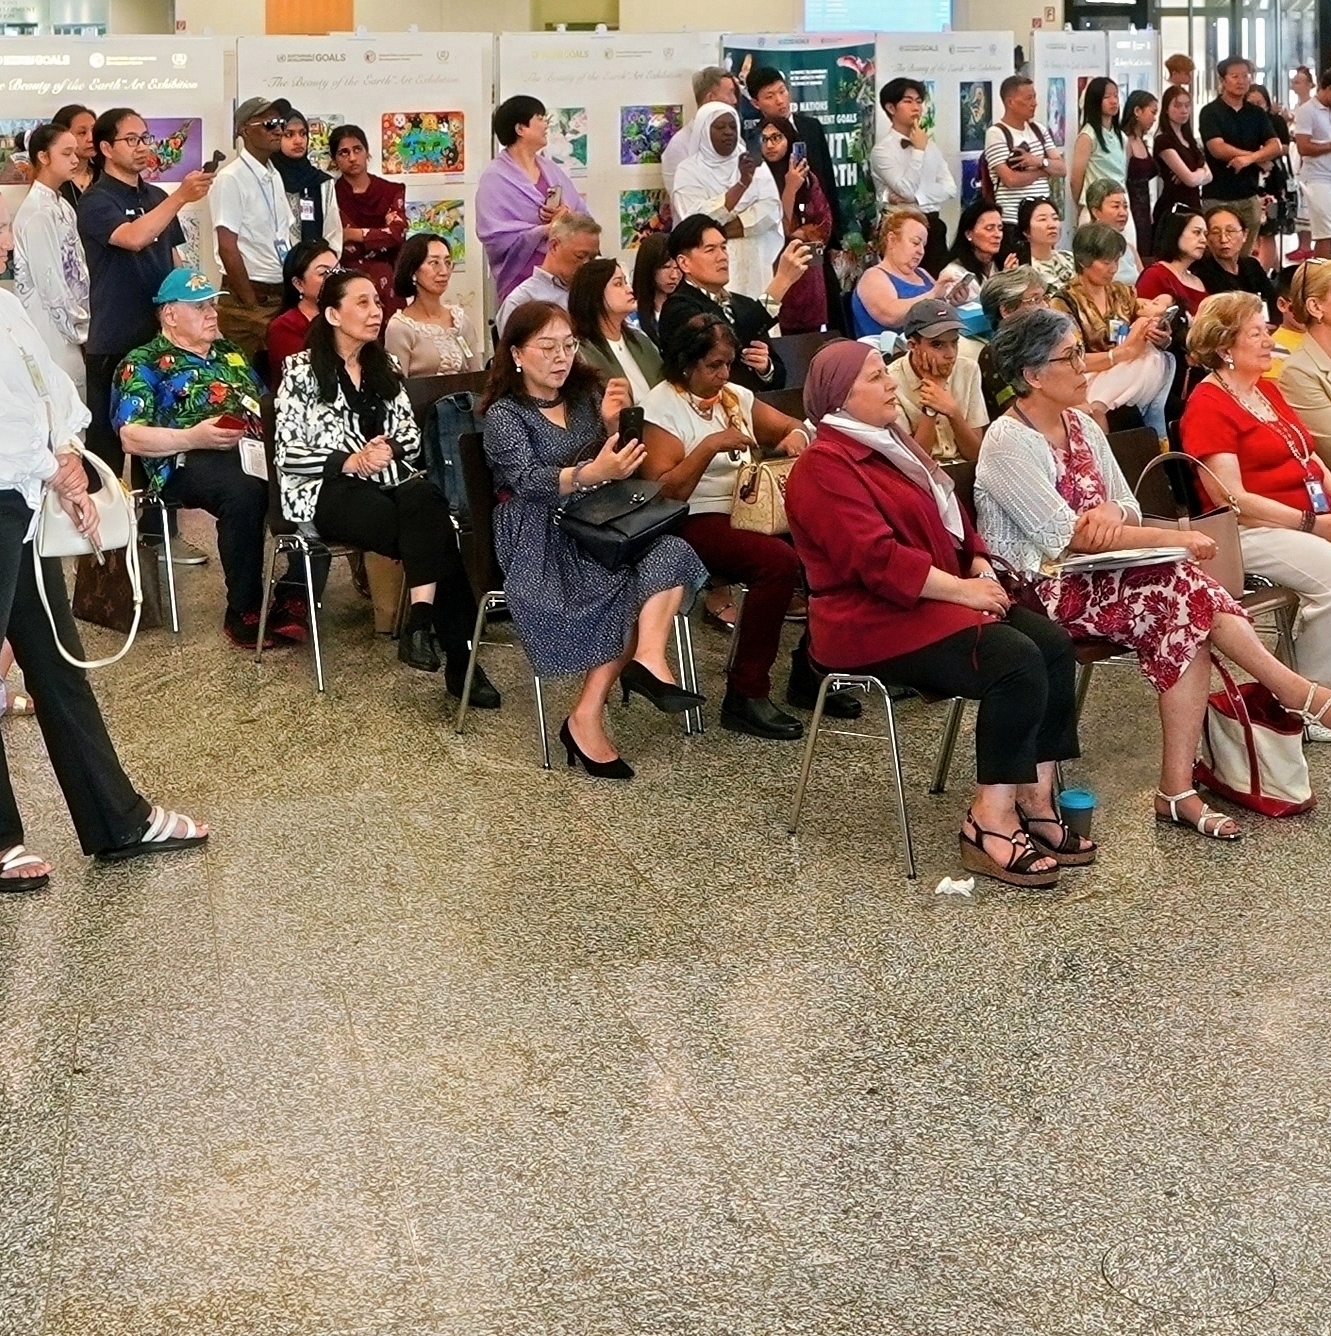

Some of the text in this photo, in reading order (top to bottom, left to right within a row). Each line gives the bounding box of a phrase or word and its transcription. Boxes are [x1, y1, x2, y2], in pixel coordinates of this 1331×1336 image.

[36, 54, 70, 66] GOALS
[315, 53, 346, 62] GOALS
[8, 78, 51, 95] Beauty
[51, 77, 68, 95] of
[67, 78, 85, 91] the
[125, 78, 145, 90] Art
[147, 77, 198, 90] Exhibition
[292, 76, 328, 91] Beauty
[331, 75, 344, 90] of
[344, 76, 360, 87] the
[800, 101, 828, 112] NATIONS
[836, 113, 857, 124] GOALS
